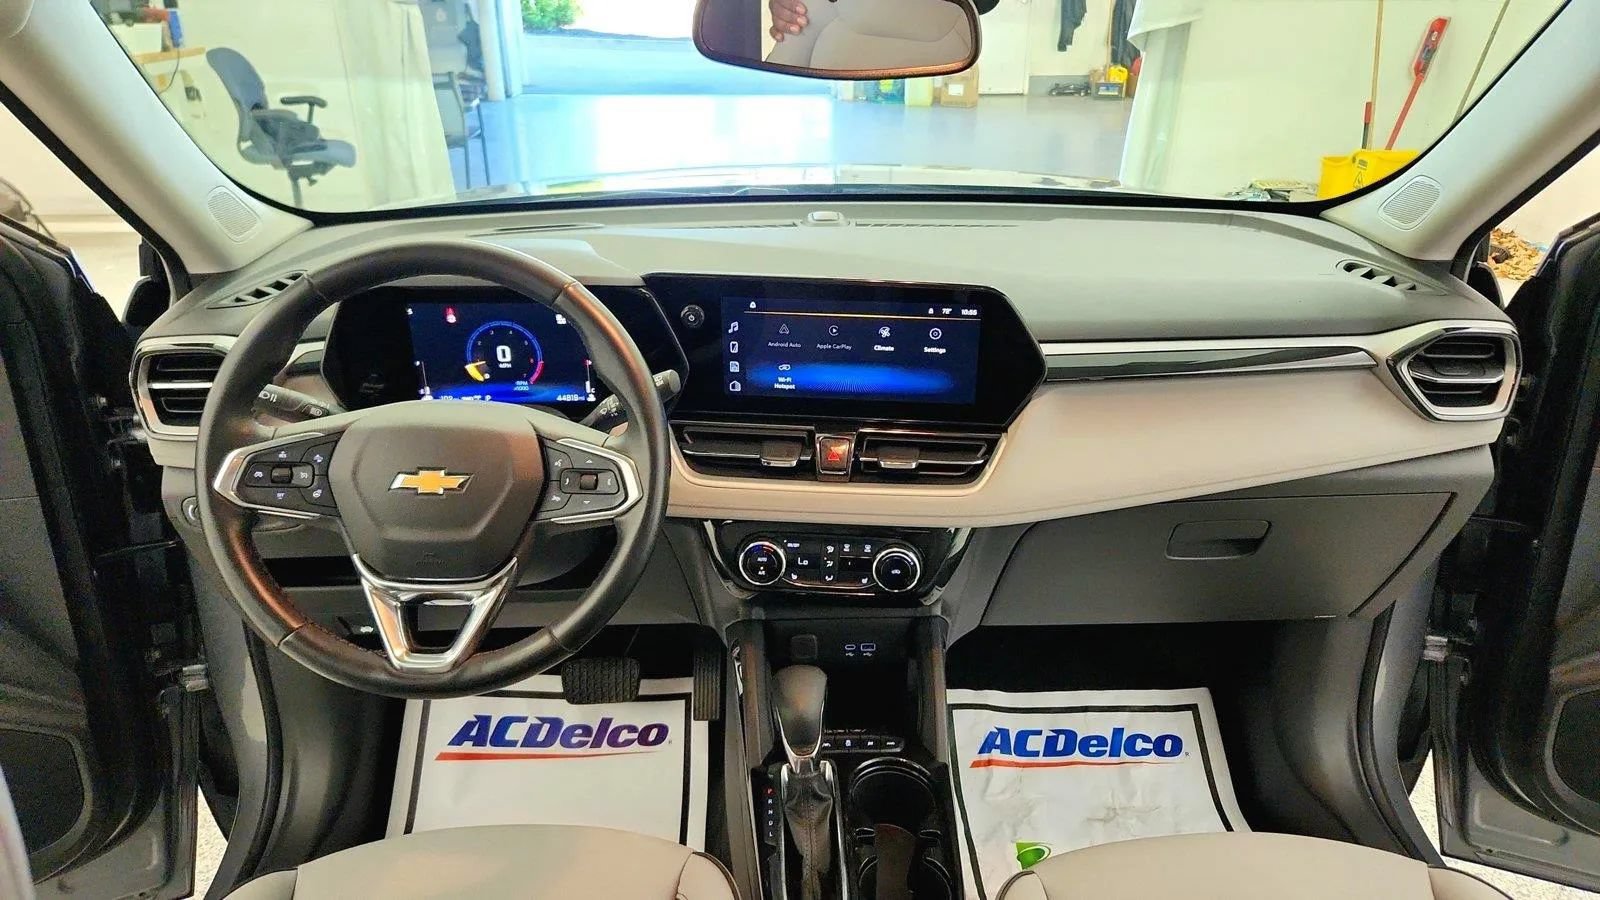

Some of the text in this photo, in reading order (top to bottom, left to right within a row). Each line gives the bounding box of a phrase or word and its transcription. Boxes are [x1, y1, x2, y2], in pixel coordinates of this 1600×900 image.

[496, 345, 512, 363] 0
[873, 344, 895, 352] Climate
[923, 346, 947, 354] Settings
[447, 715, 669, 749] ACDelco
[977, 726, 1183, 758] ACDelco
